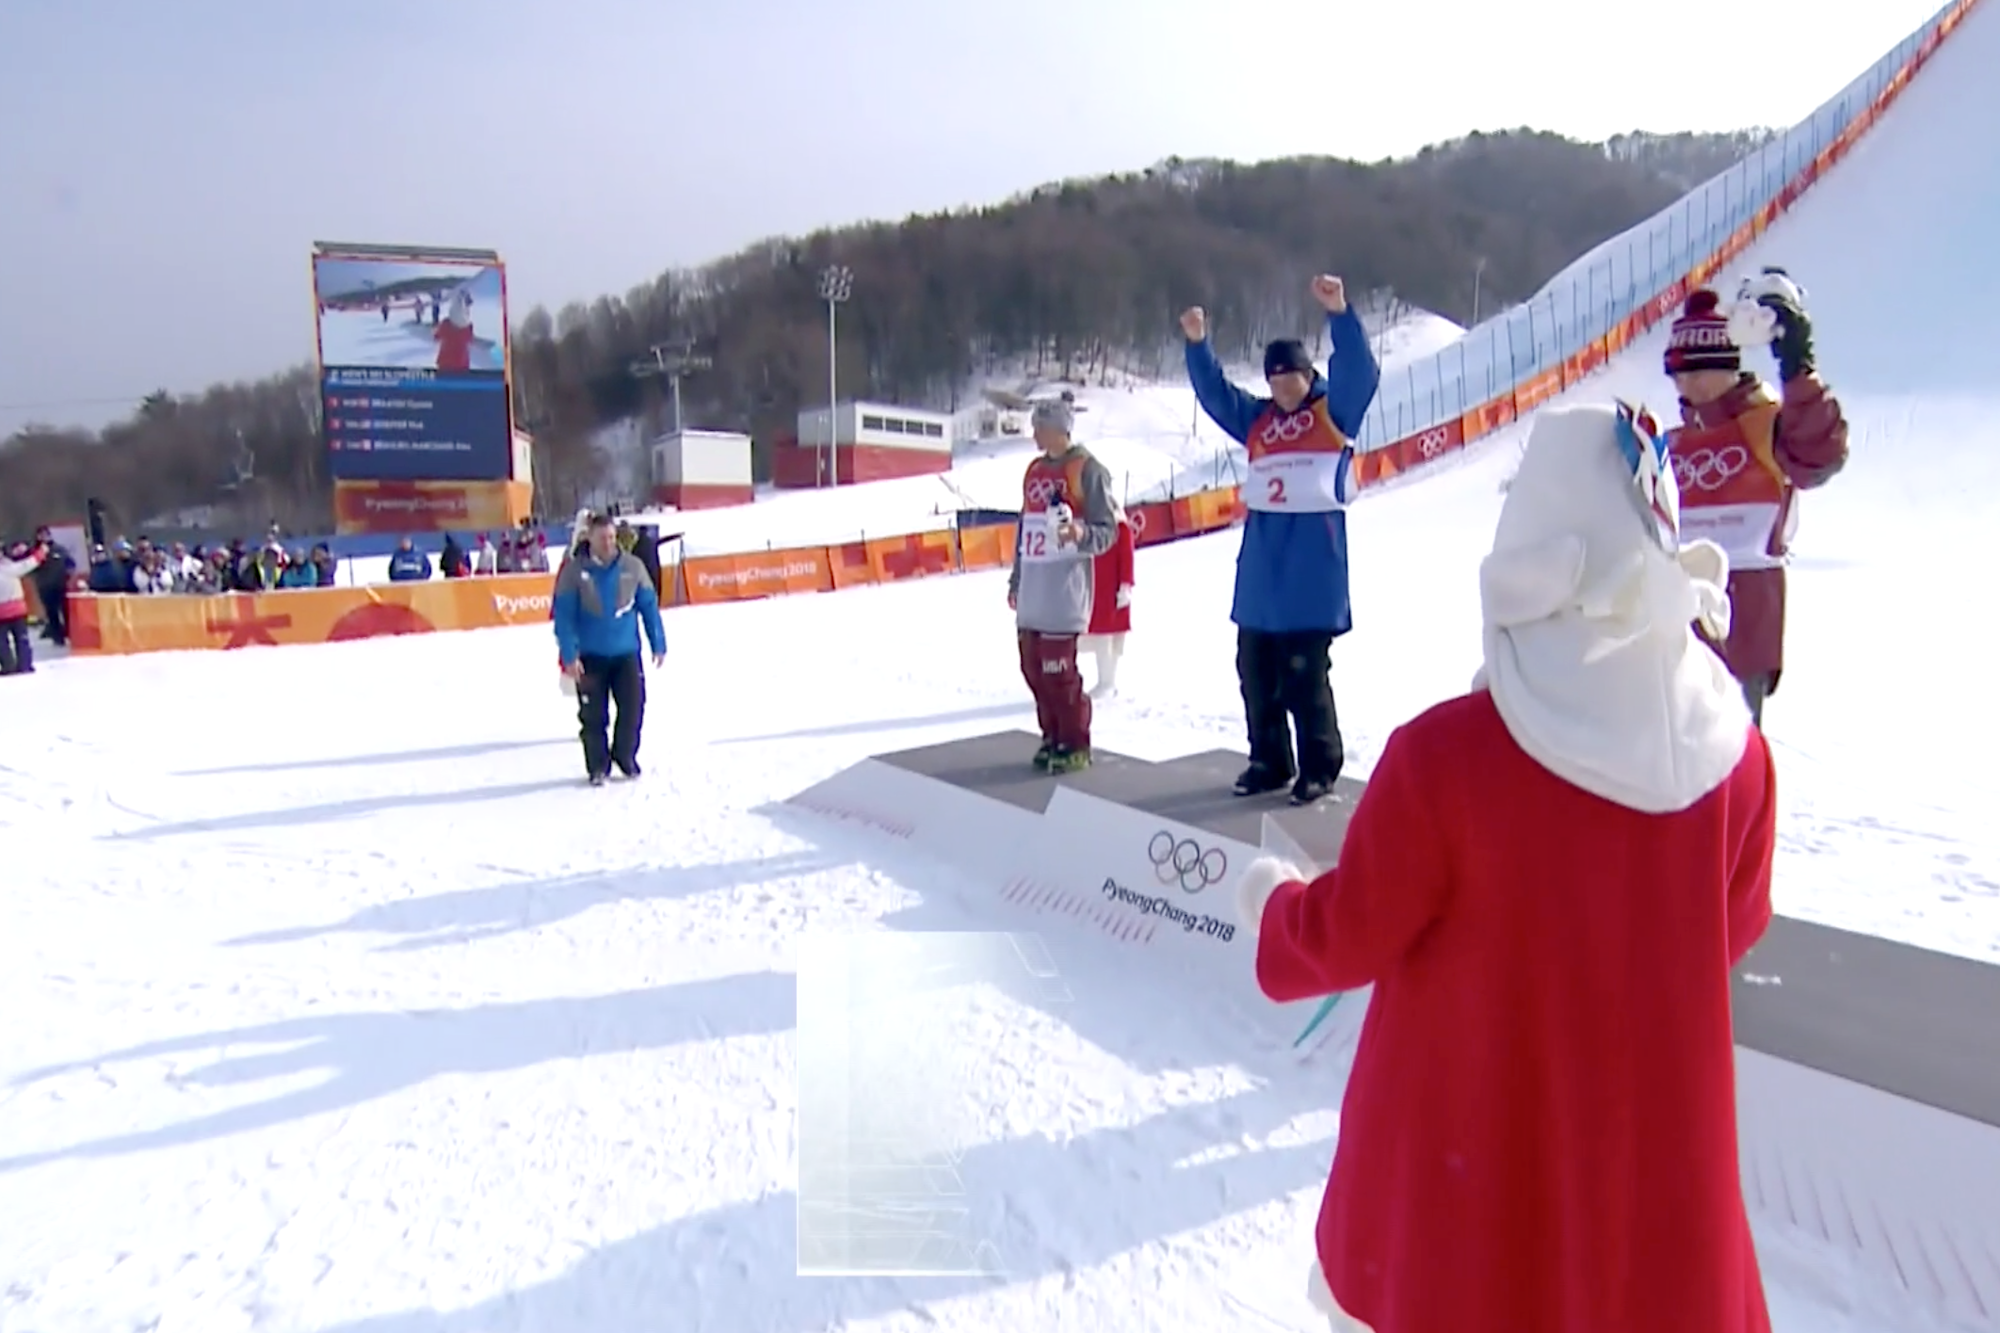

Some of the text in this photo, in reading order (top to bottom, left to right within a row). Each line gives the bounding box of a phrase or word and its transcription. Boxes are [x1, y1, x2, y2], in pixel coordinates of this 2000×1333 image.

[1267, 477, 1287, 504] 2
[1025, 531, 1046, 556] 12
[1102, 876, 1236, 943] PyeongChang 2018
